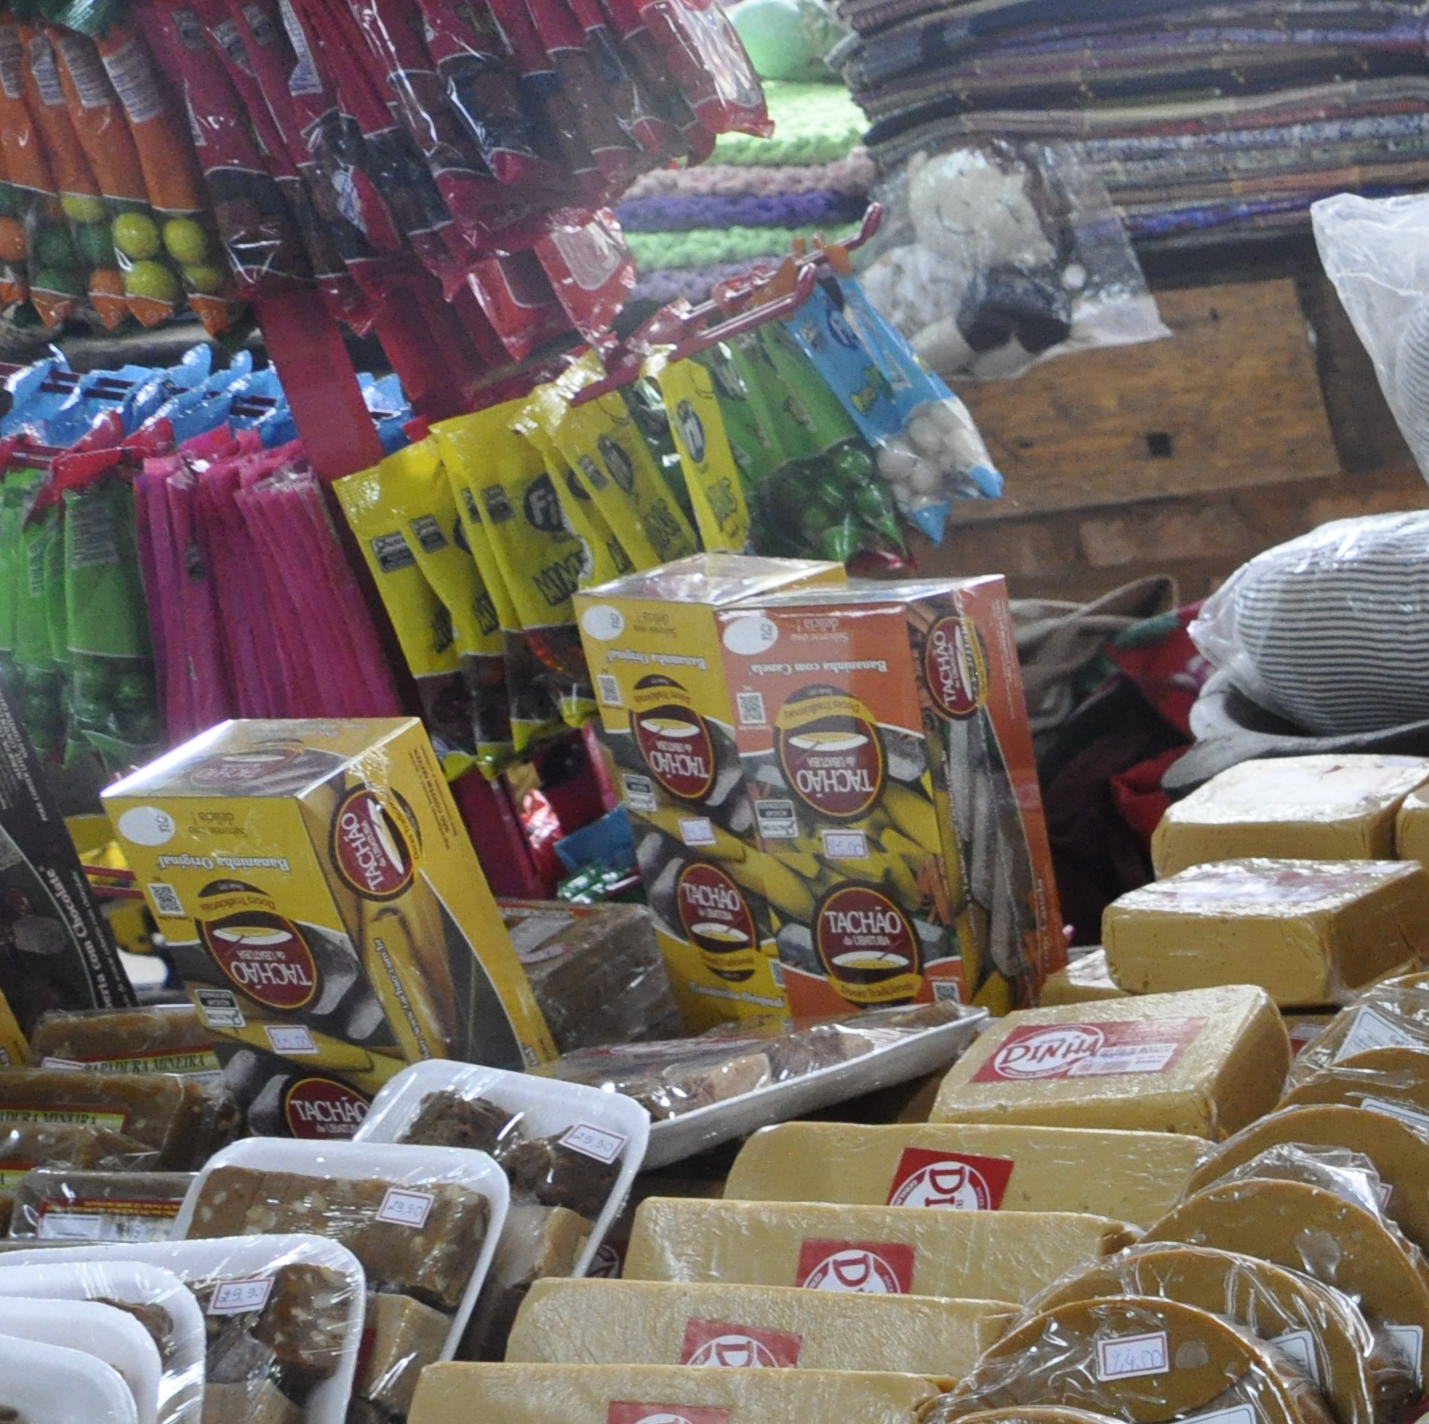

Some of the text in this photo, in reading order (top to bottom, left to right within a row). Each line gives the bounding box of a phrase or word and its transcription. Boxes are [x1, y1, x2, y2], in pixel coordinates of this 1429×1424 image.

[931, 630, 953, 704] TACHÃO
[796, 769, 875, 798] TACHÃO
[341, 813, 387, 891] TACHÃO
[681, 883, 741, 911] TACHÃO
[824, 907, 901, 935] TACHÃO
[232, 960, 312, 990] TACHÃO
[1002, 1041, 1105, 1062] DINHA
[289, 1096, 370, 1122] TACHÃO
